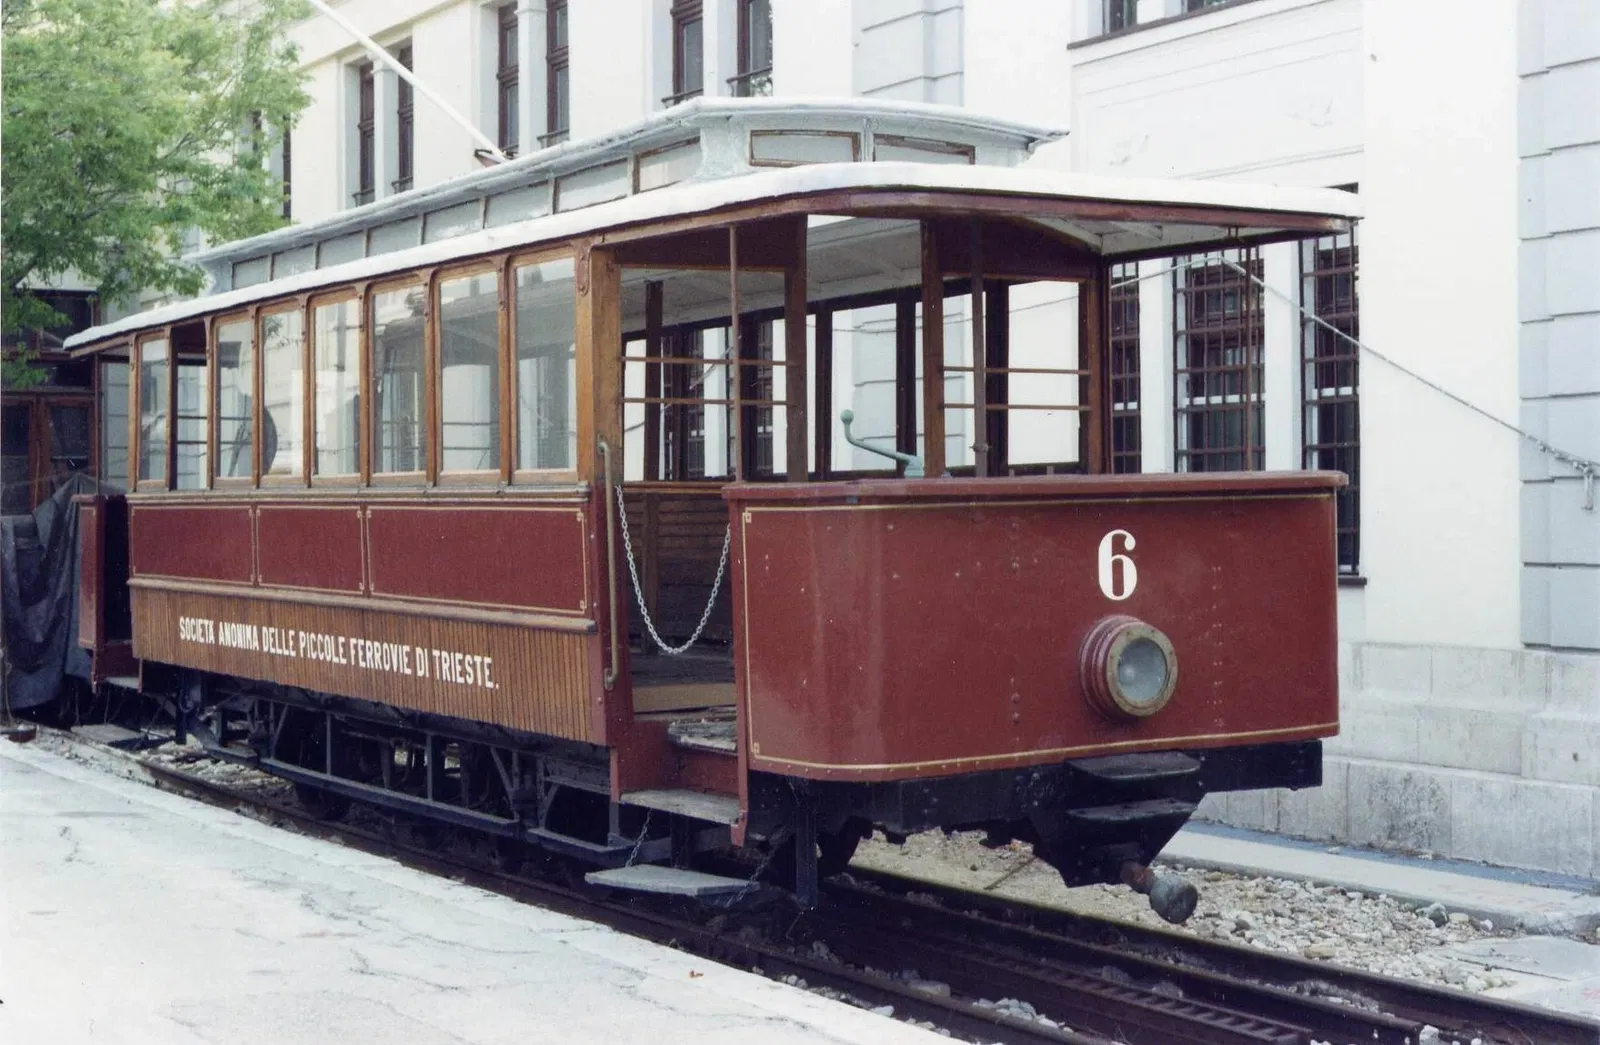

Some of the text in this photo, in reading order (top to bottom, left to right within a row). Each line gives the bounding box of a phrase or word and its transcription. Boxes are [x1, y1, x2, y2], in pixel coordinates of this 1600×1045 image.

[1098, 529, 1137, 600] 6
[218, 621, 259, 651] ANONIMA
[262, 626, 296, 657] DELLE
[299, 630, 347, 665] PICCOLE
[350, 637, 412, 675] FERROVIE
[415, 647, 429, 678] DI
[432, 649, 499, 689] TRIESTE.
